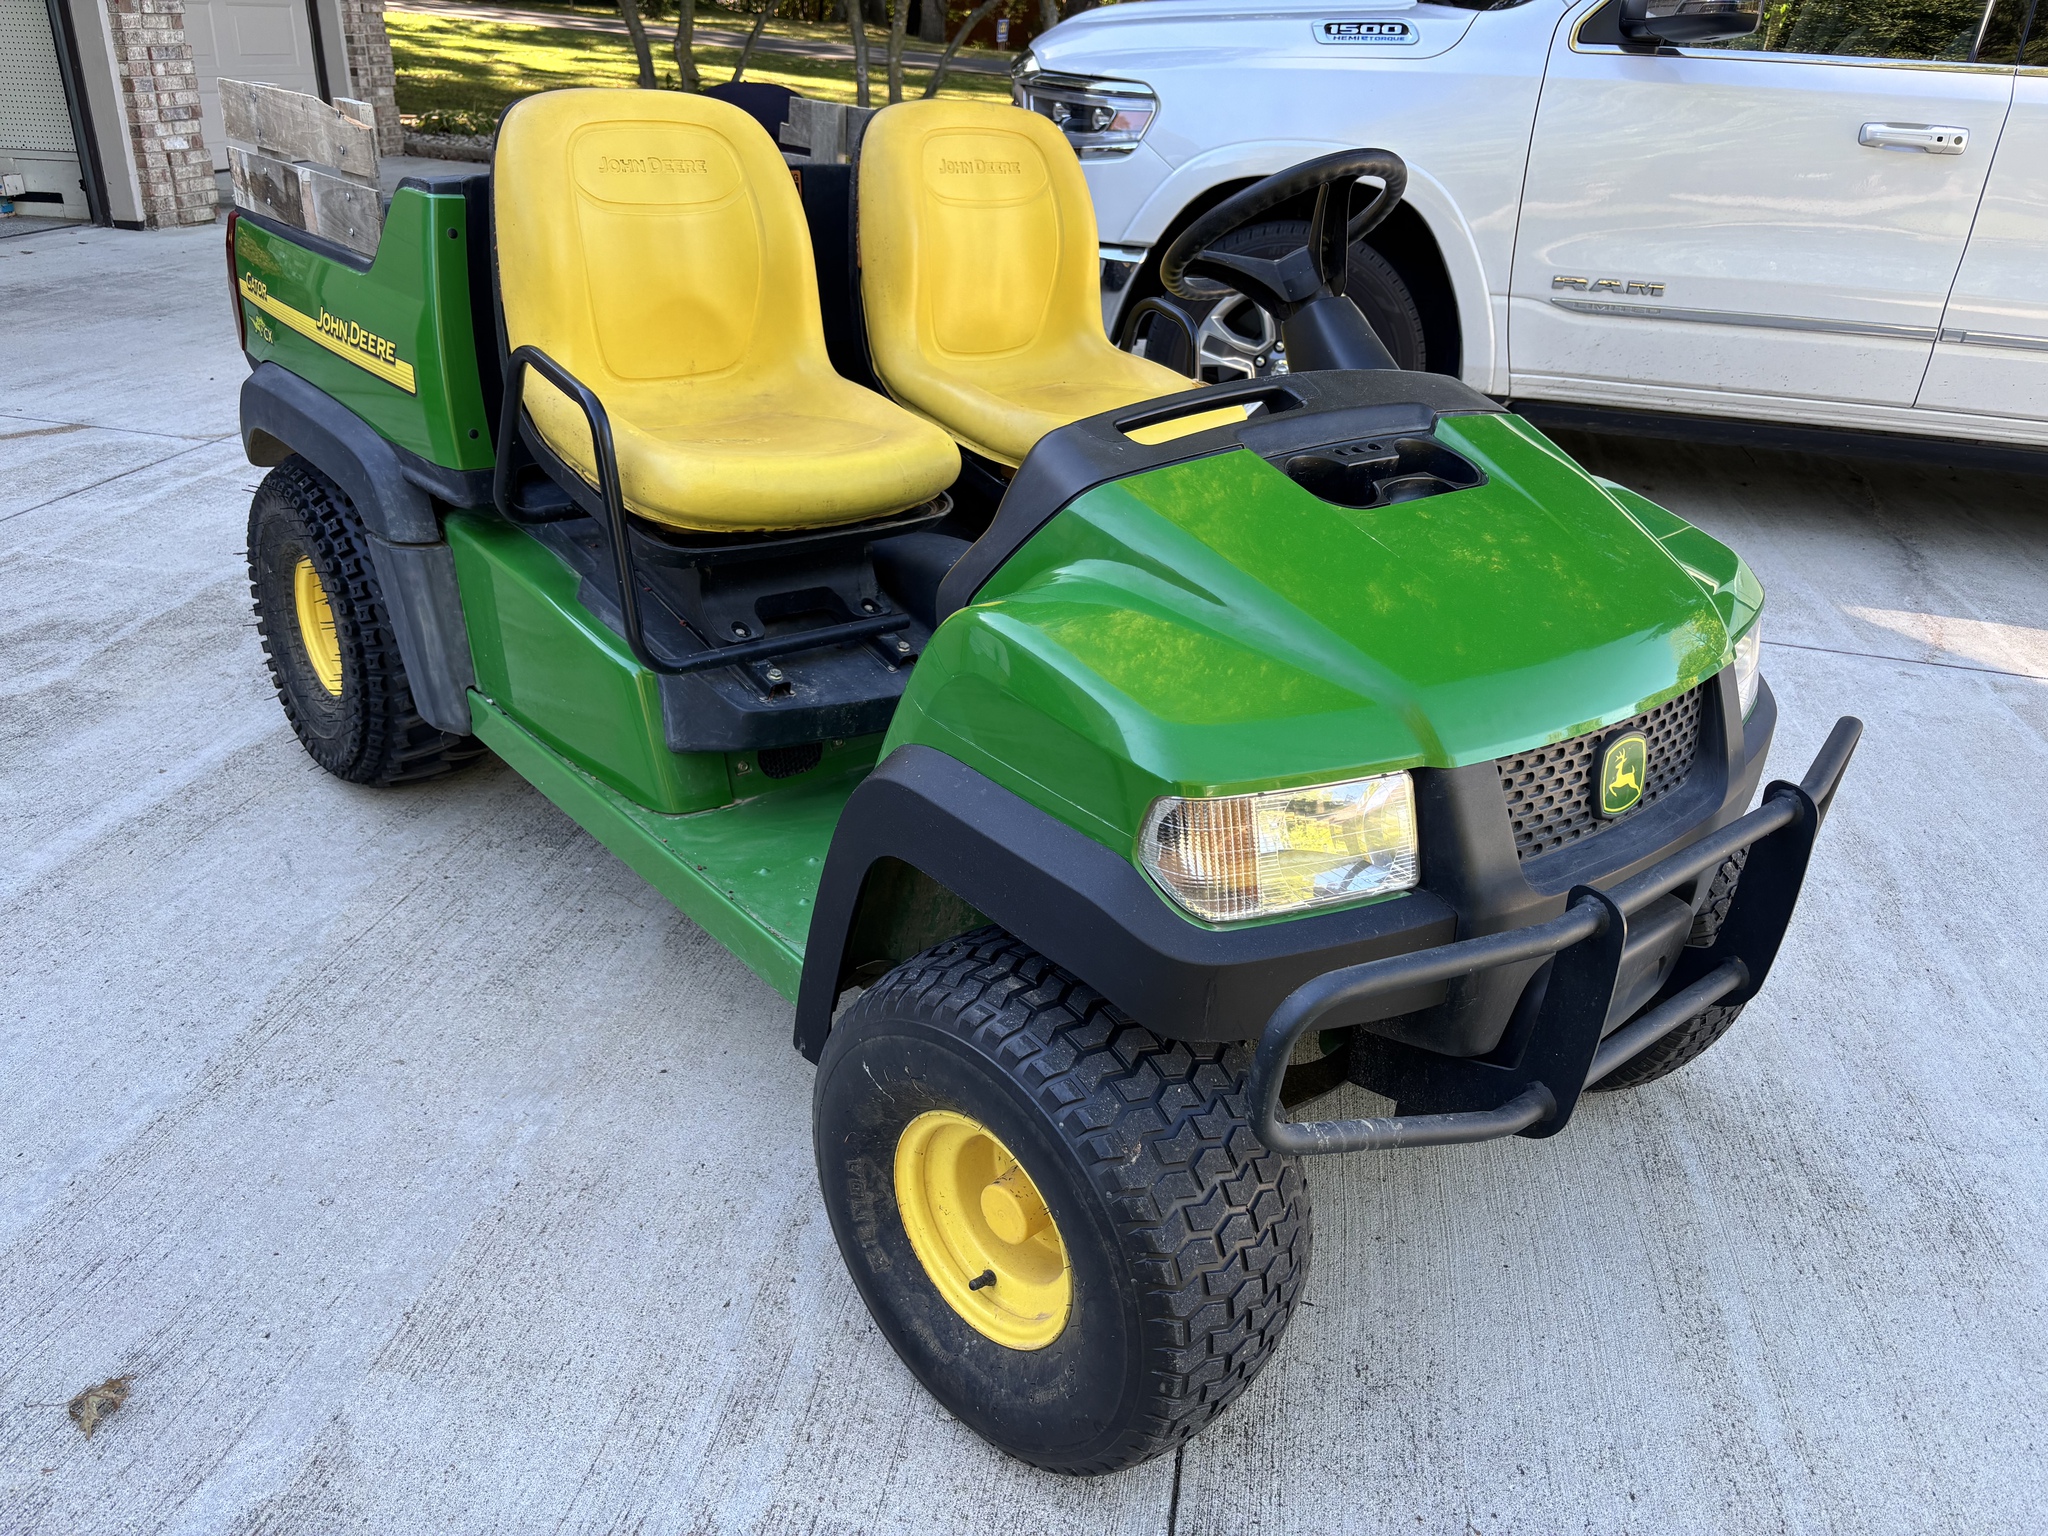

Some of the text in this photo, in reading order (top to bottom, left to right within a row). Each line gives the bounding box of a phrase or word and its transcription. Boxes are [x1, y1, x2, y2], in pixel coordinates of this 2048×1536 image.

[1329, 24, 1402, 34] 1500
[598, 156, 707, 174] JOHN DEERE
[939, 158, 1021, 175] JOHN DEERE
[245, 271, 268, 301] GATOR
[1551, 275, 1665, 297] RAM
[1573, 301, 1661, 315] LIMITED
[263, 326, 275, 345] CX
[316, 305, 397, 364] JOHN DEERE
